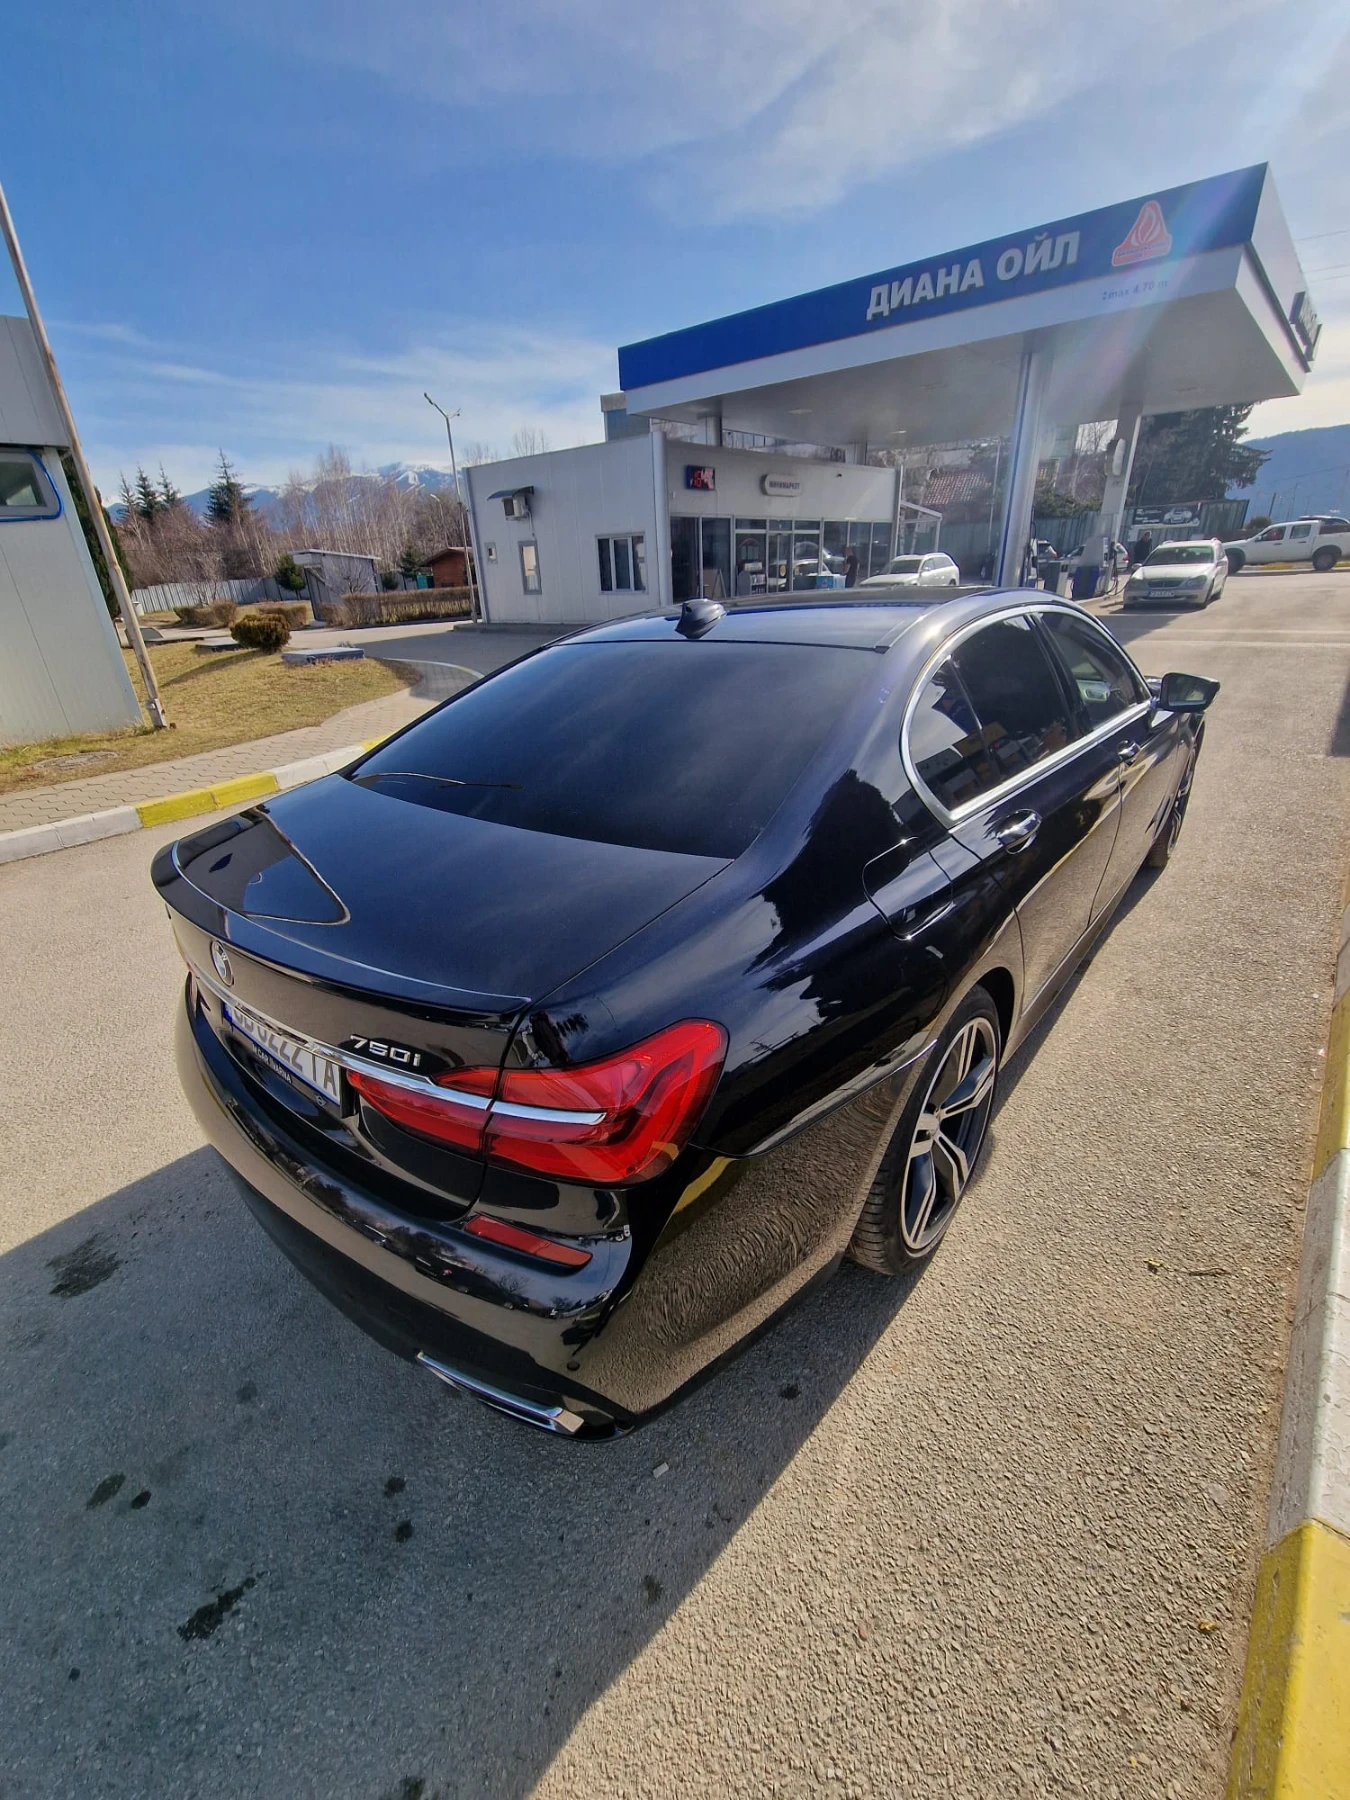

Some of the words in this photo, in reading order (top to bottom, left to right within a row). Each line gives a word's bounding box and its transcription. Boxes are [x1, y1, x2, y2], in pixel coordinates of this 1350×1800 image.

[866, 259, 985, 321] ДИАНА
[996, 231, 1081, 281] ОЙЛ
[350, 1034, 421, 1067] 750i
